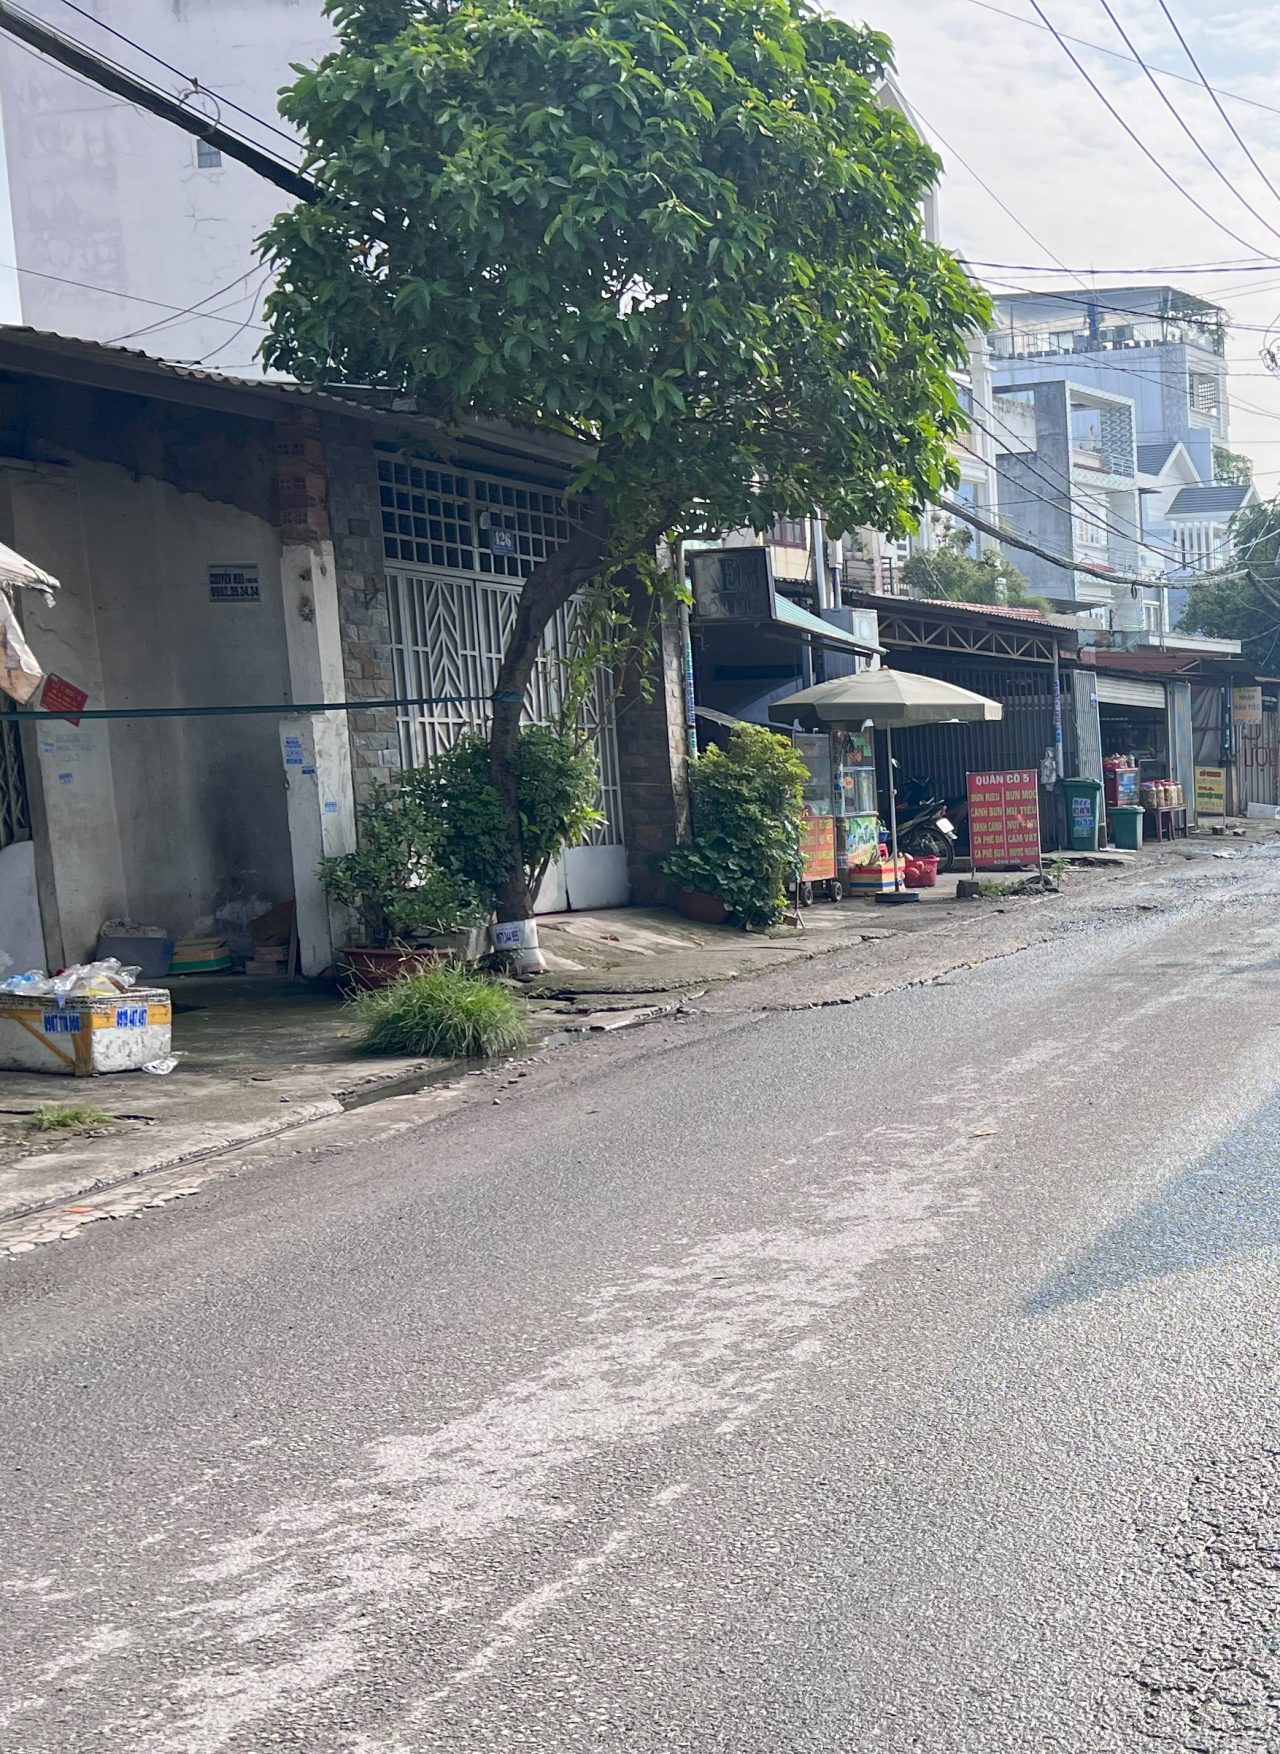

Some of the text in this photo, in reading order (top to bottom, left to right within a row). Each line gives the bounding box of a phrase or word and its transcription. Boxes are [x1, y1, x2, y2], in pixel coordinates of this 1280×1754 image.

[495, 531, 512, 547] 126
[975, 773, 1029, 786] QUÁN CÔ 5
